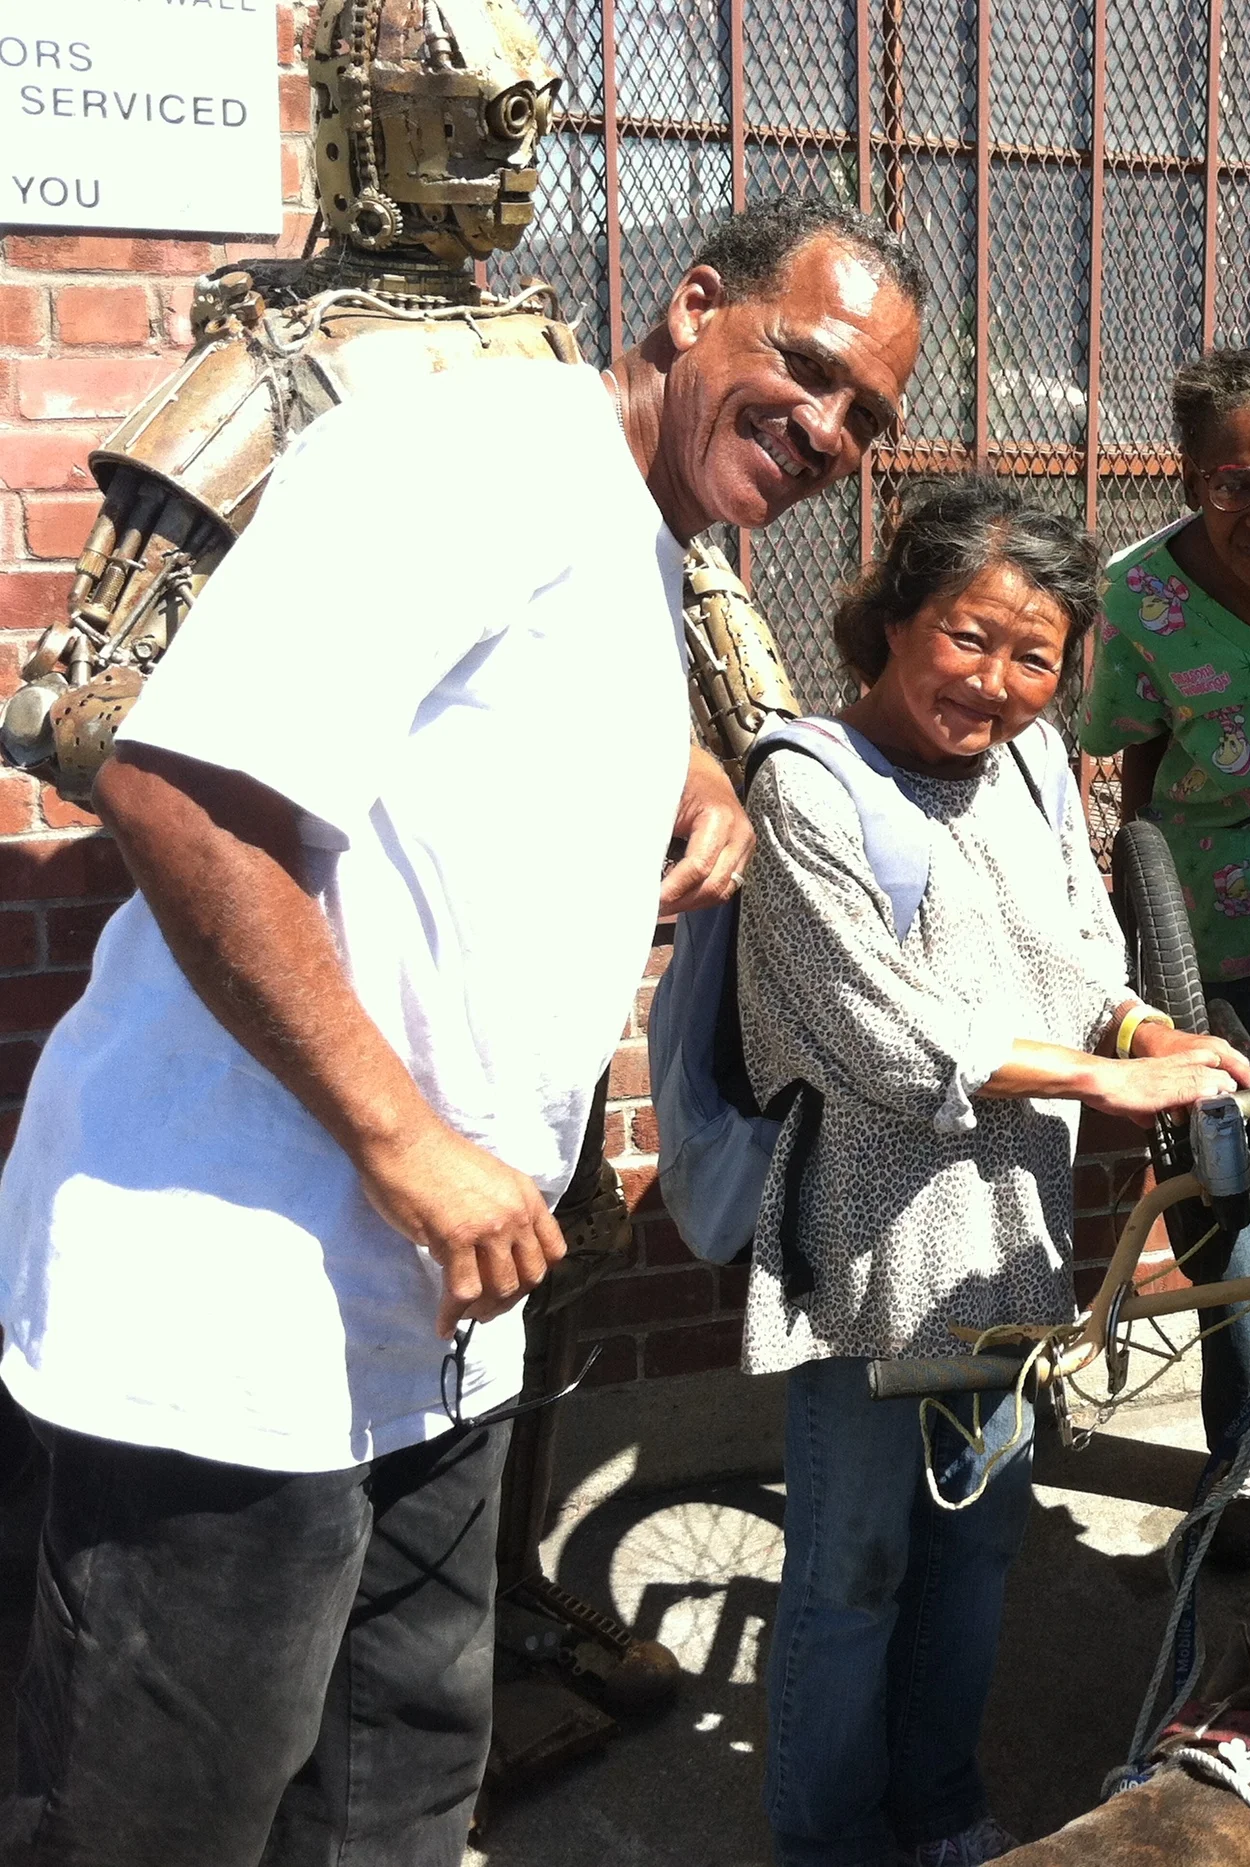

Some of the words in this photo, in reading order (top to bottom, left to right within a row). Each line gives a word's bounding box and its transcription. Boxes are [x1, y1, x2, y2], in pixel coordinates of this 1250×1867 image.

[20, 85, 248, 127] SERVICED
[12, 175, 100, 209] YOU
[1176, 1616, 1192, 1672] Mobile
